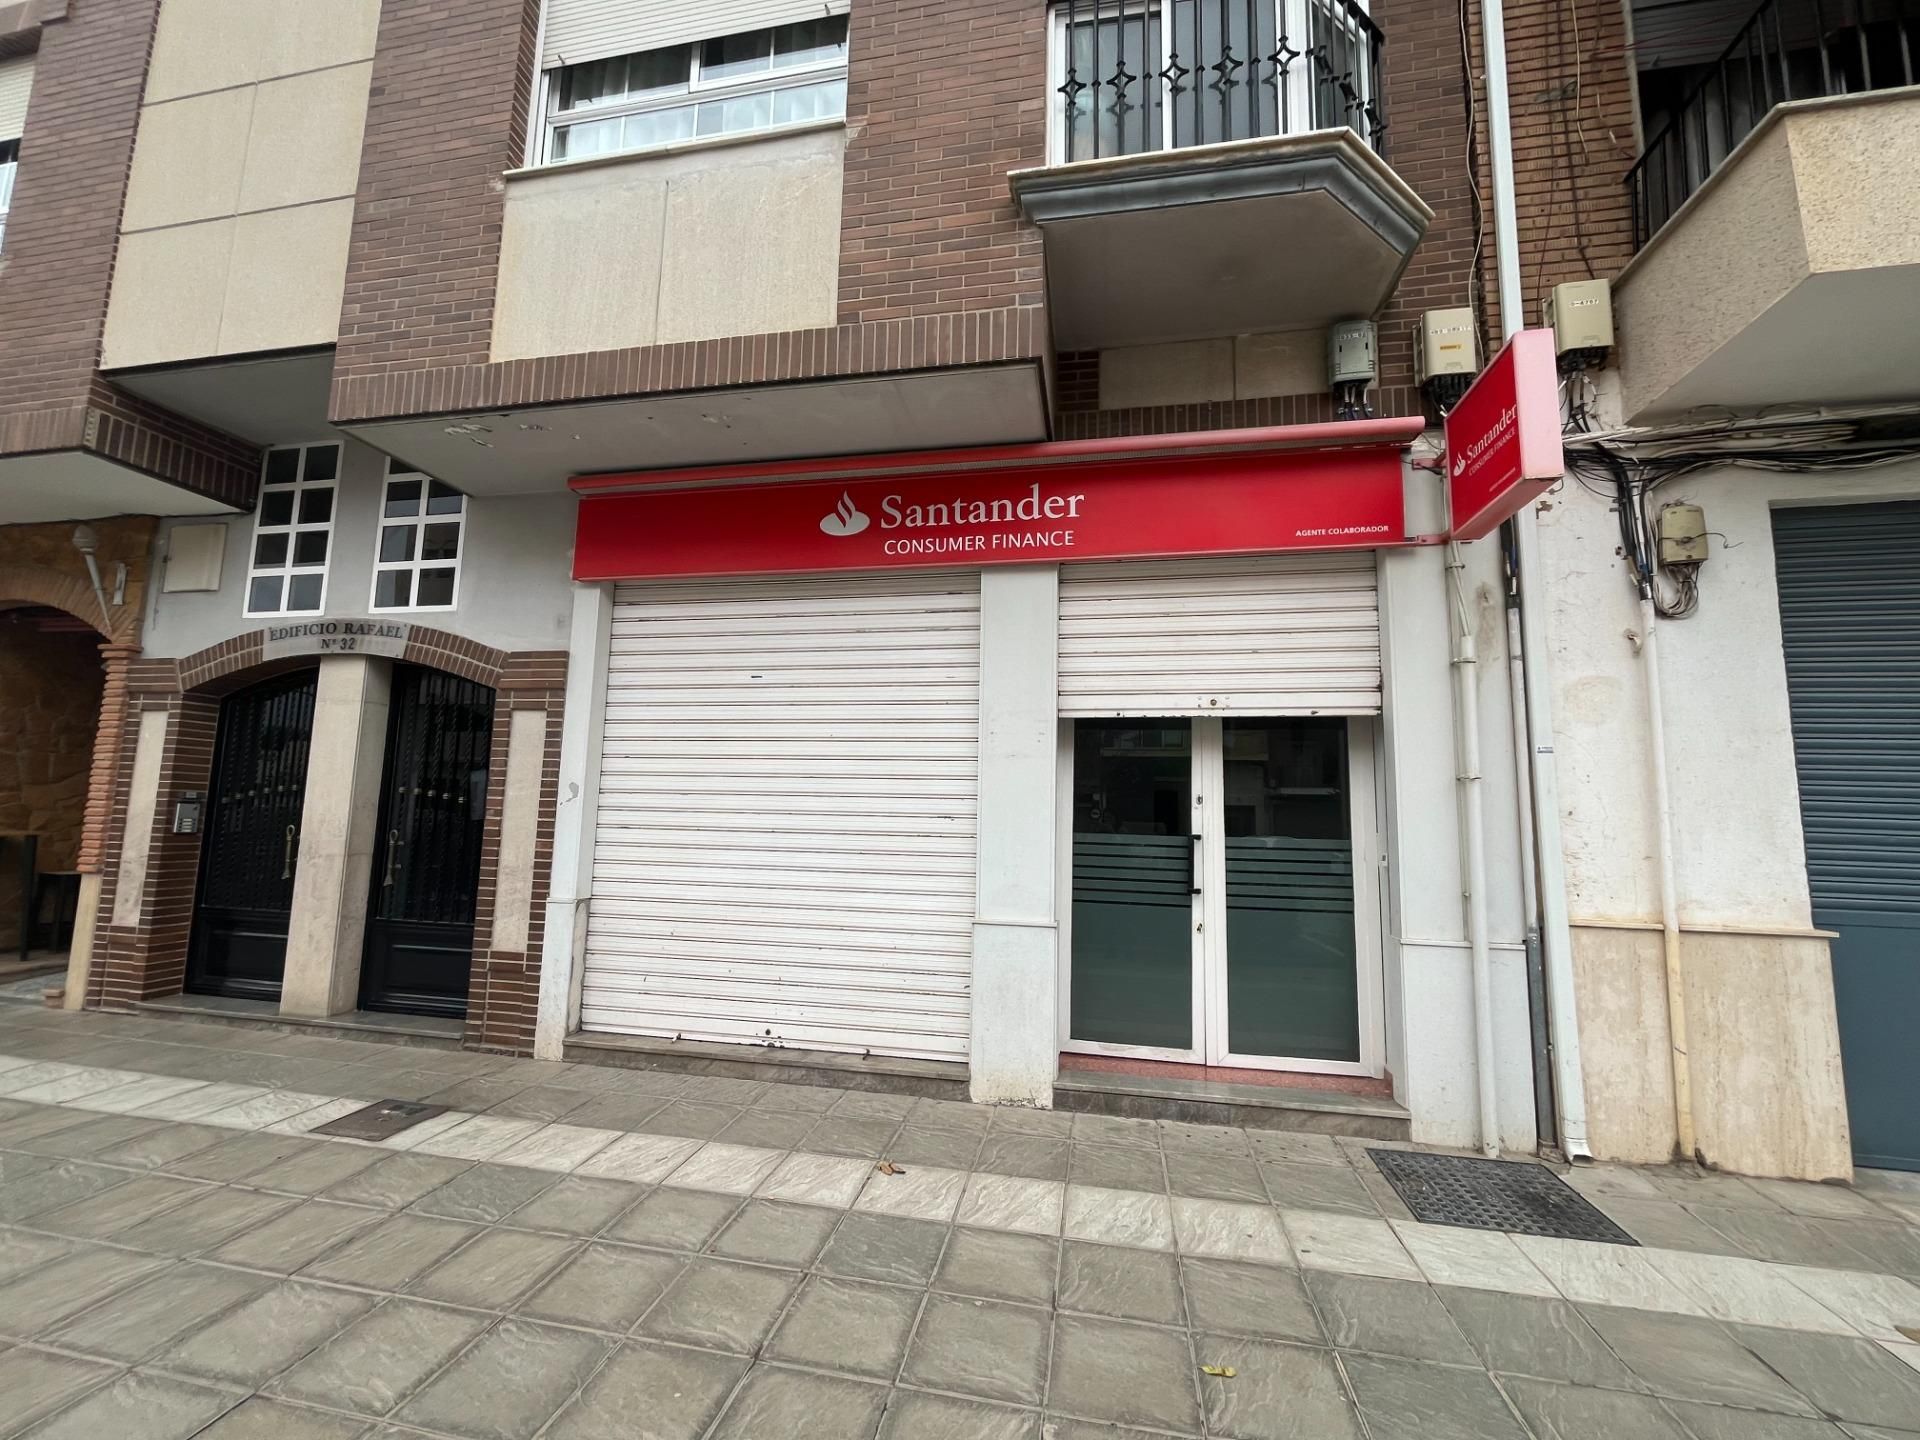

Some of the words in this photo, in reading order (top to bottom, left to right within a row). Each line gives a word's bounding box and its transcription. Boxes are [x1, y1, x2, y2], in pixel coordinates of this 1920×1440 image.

[1466, 404, 1517, 464] Santander
[880, 482, 1085, 529] Santander
[1295, 528, 1326, 537] AGENTE
[1328, 525, 1389, 535] COLABORADOR
[884, 535, 986, 554] CONSUMER
[992, 530, 1075, 549] FINANCE
[269, 622, 337, 641] EDIFICIO
[343, 622, 403, 639] RAFAEL
[339, 638, 355, 650] 32
